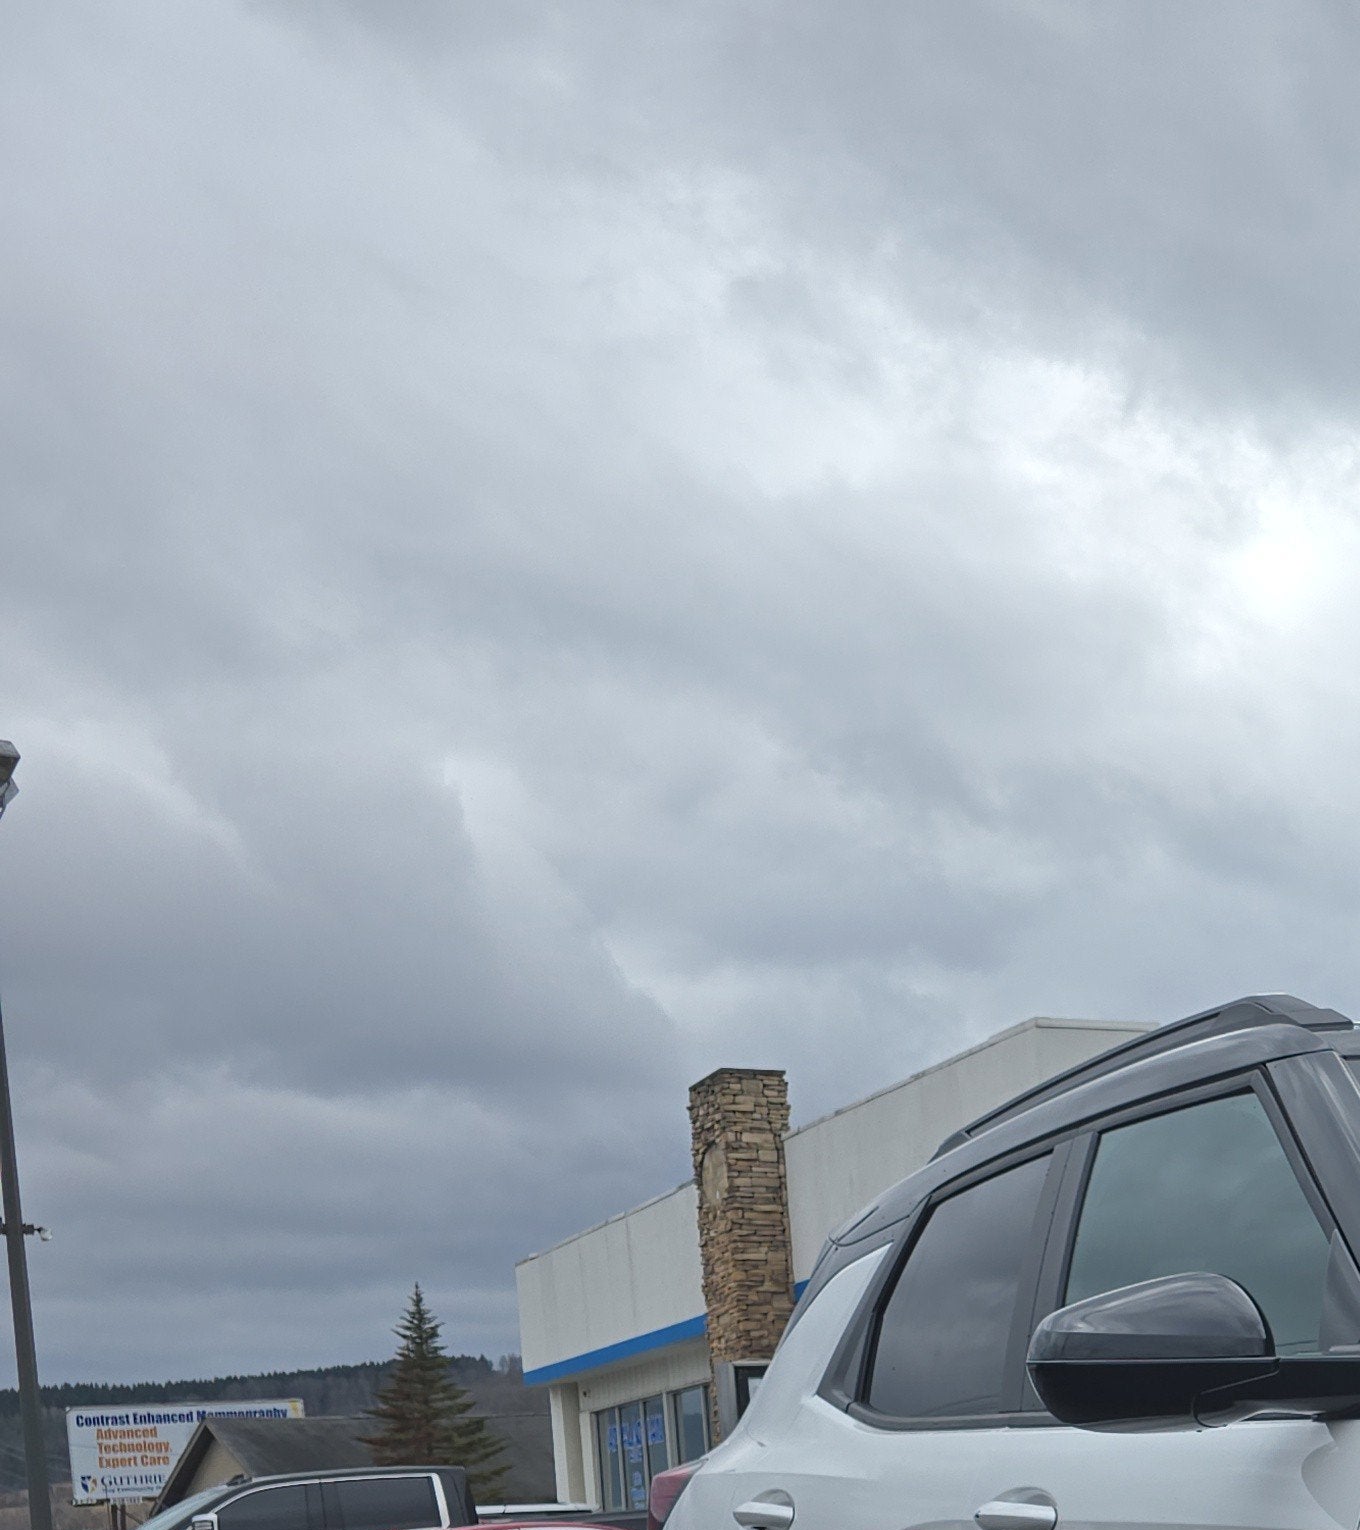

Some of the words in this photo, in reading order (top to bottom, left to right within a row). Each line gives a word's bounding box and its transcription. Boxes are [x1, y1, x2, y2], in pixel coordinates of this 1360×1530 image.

[76, 1413, 130, 1428] Contrast
[132, 1410, 194, 1425] Enhanced
[96, 1426, 158, 1440] Advanced
[98, 1456, 138, 1469] Expert
[140, 1454, 170, 1467] Care
[101, 1474, 166, 1487] GUTHRIE
